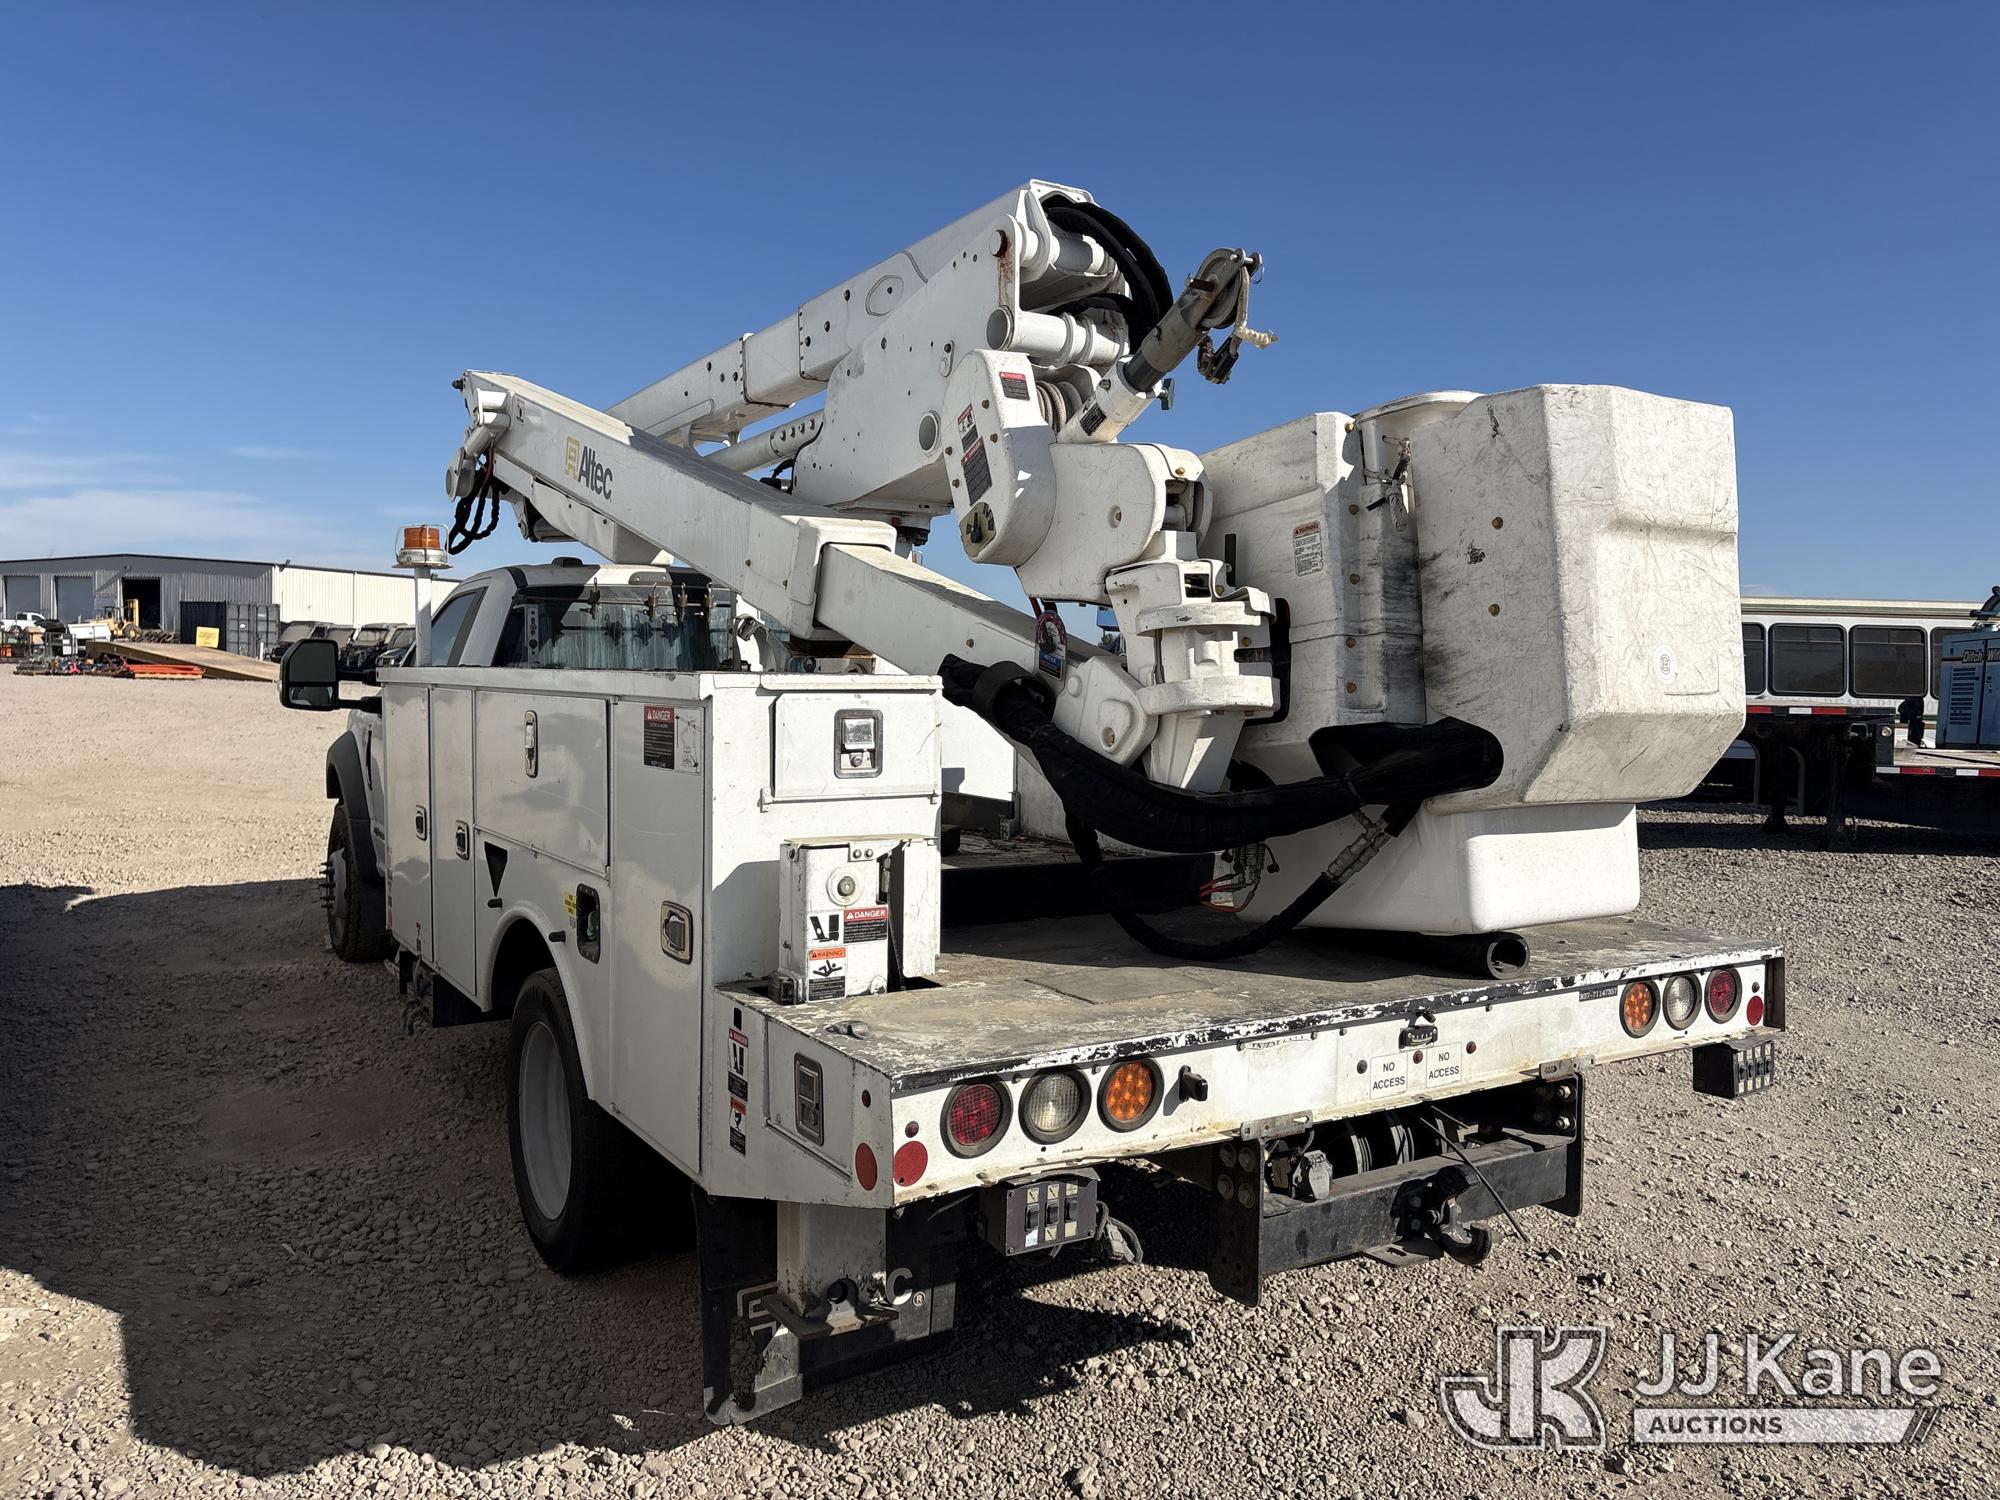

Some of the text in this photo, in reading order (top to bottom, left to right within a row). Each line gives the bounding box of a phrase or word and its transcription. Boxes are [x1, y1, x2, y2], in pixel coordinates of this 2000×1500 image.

[578, 446, 613, 499] Altec
[1963, 650, 1983, 663] Ditch
[651, 709, 671, 721] DANGER
[854, 909, 886, 919] DANGER
[817, 950, 843, 958] WARNING
[1438, 1051, 1450, 1062] NO
[1382, 1061, 1395, 1073] NO
[1428, 1065, 1460, 1080] ACCESS
[1372, 1076, 1406, 1090] ACCESS
